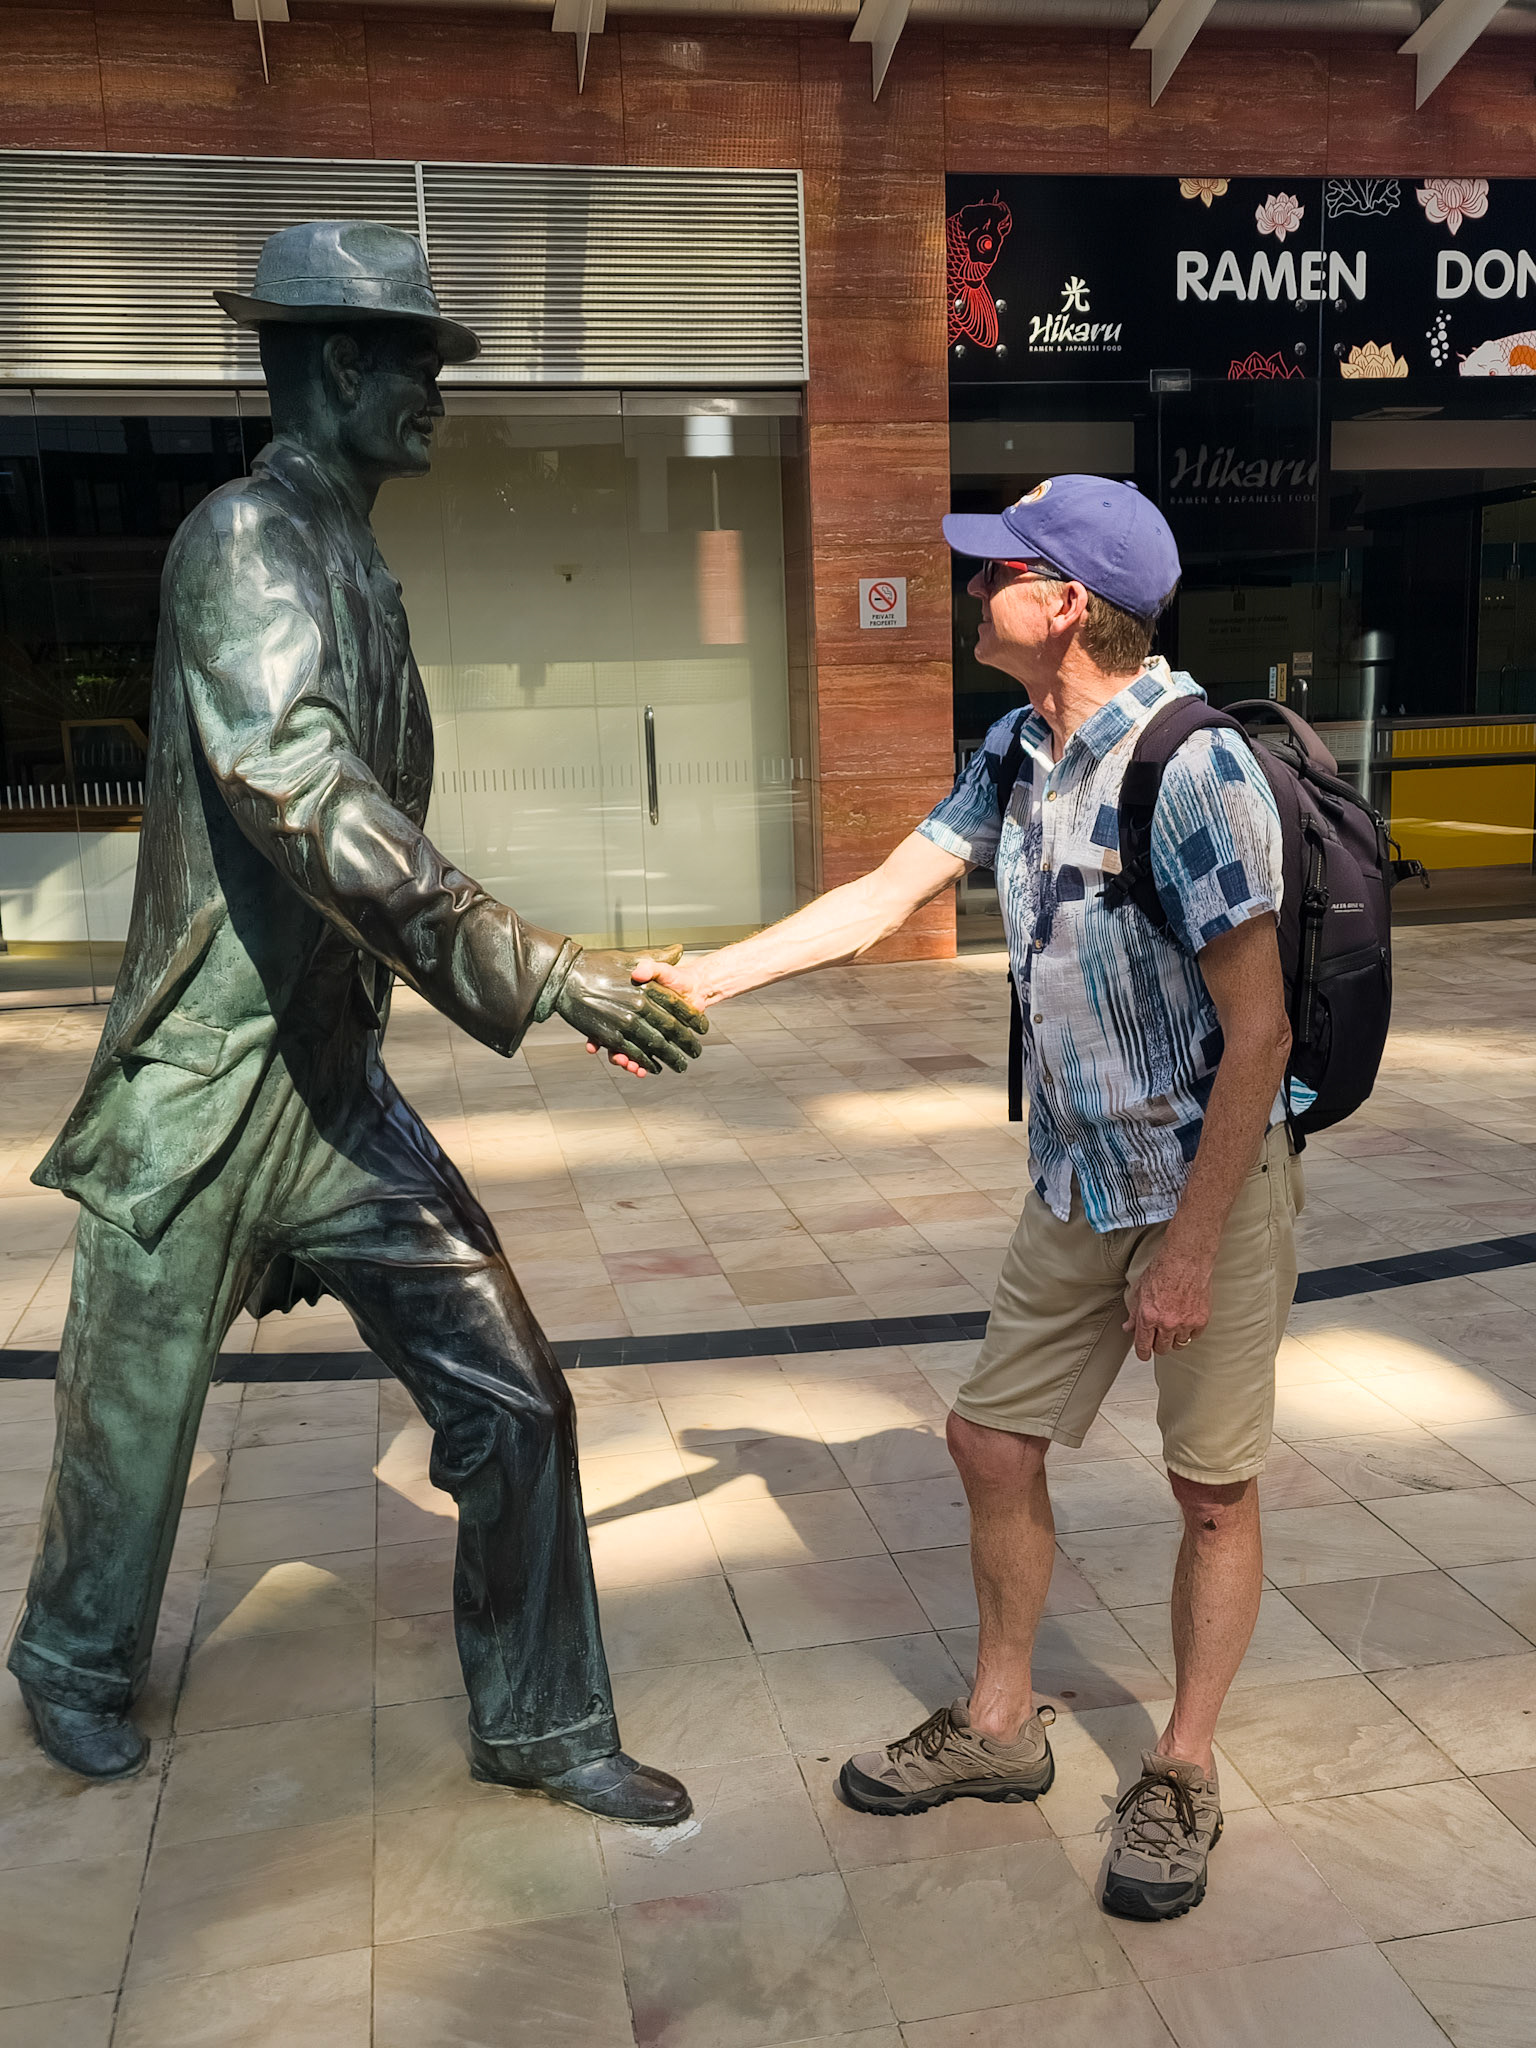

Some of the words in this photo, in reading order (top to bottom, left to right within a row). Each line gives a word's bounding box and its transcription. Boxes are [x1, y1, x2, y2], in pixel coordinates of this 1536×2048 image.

[1177, 250, 1367, 301] RAMEN
[1060, 275, 1091, 313] 光
[1028, 313, 1123, 344] Hikaru
[1028, 344, 1054, 352] RAMEN
[1056, 344, 1062, 352] &
[1065, 344, 1099, 352] JAPANESE
[1102, 344, 1122, 352] FOOD
[1170, 444, 1319, 488] Hikaru
[1169, 496, 1208, 505] RAMEN
[1228, 495, 1282, 504] JAPANESE
[1288, 494, 1319, 503] FOOD
